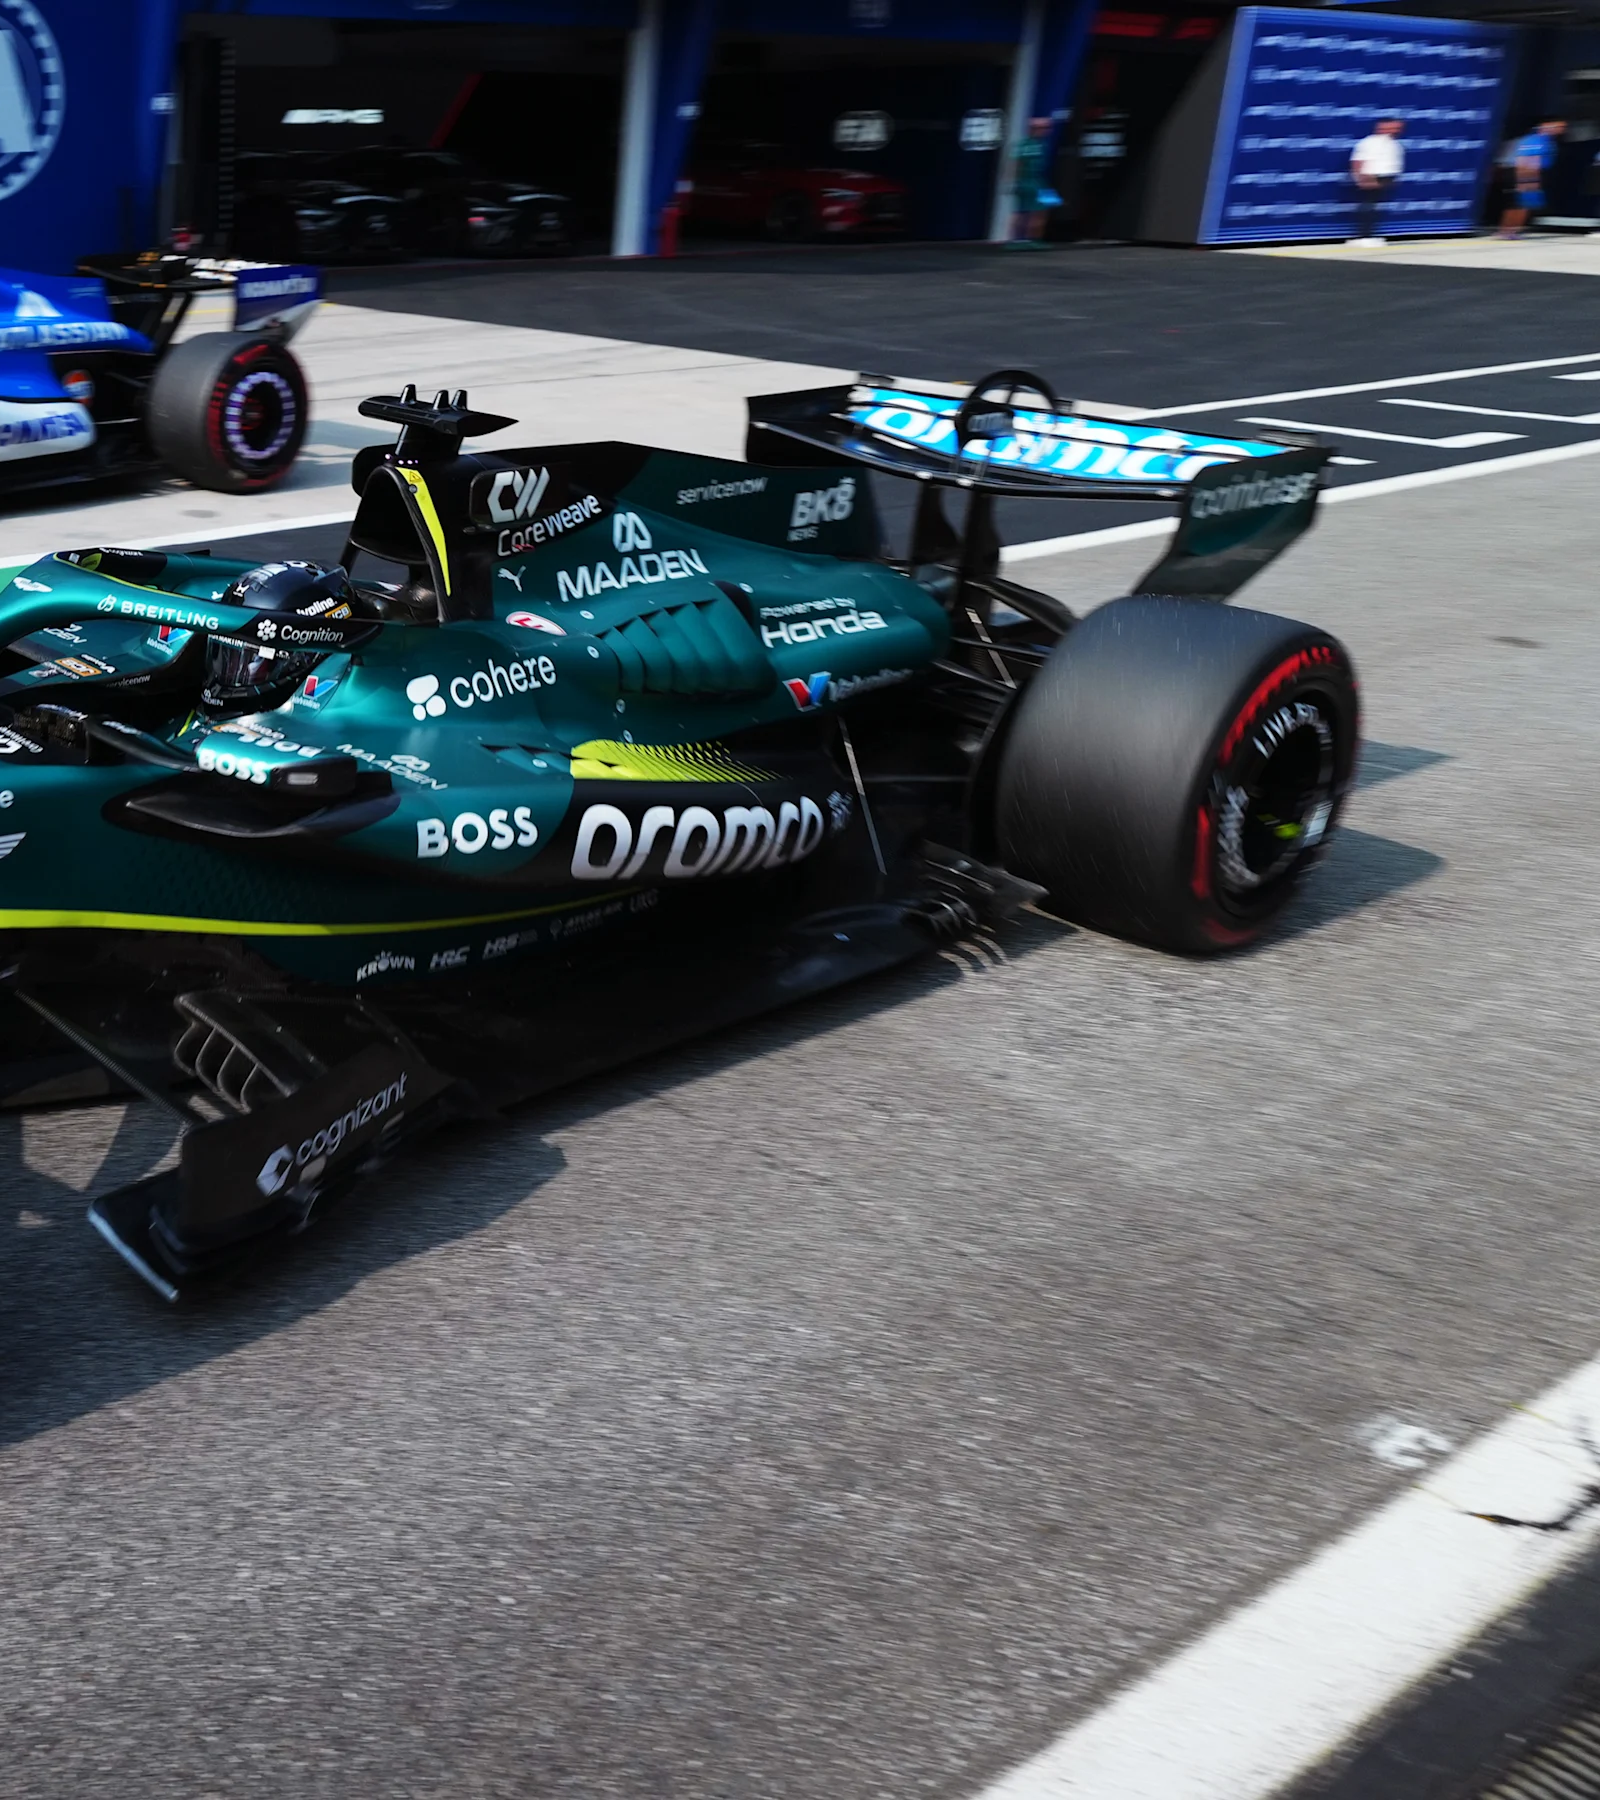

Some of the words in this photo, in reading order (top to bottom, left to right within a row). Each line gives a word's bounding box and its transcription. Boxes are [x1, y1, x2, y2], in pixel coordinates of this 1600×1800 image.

[557, 547, 710, 602] MAADEN
[120, 601, 219, 630] BREITLING
[280, 624, 344, 645] Cognition
[760, 609, 889, 648] Honda
[449, 654, 557, 708] cohere
[197, 748, 267, 785] BOSS
[336, 743, 448, 790] MAADEN
[416, 806, 539, 858] BOSS
[571, 796, 825, 881] aramco
[357, 952, 416, 982] KROWN
[296, 1072, 408, 1167] cognizant
